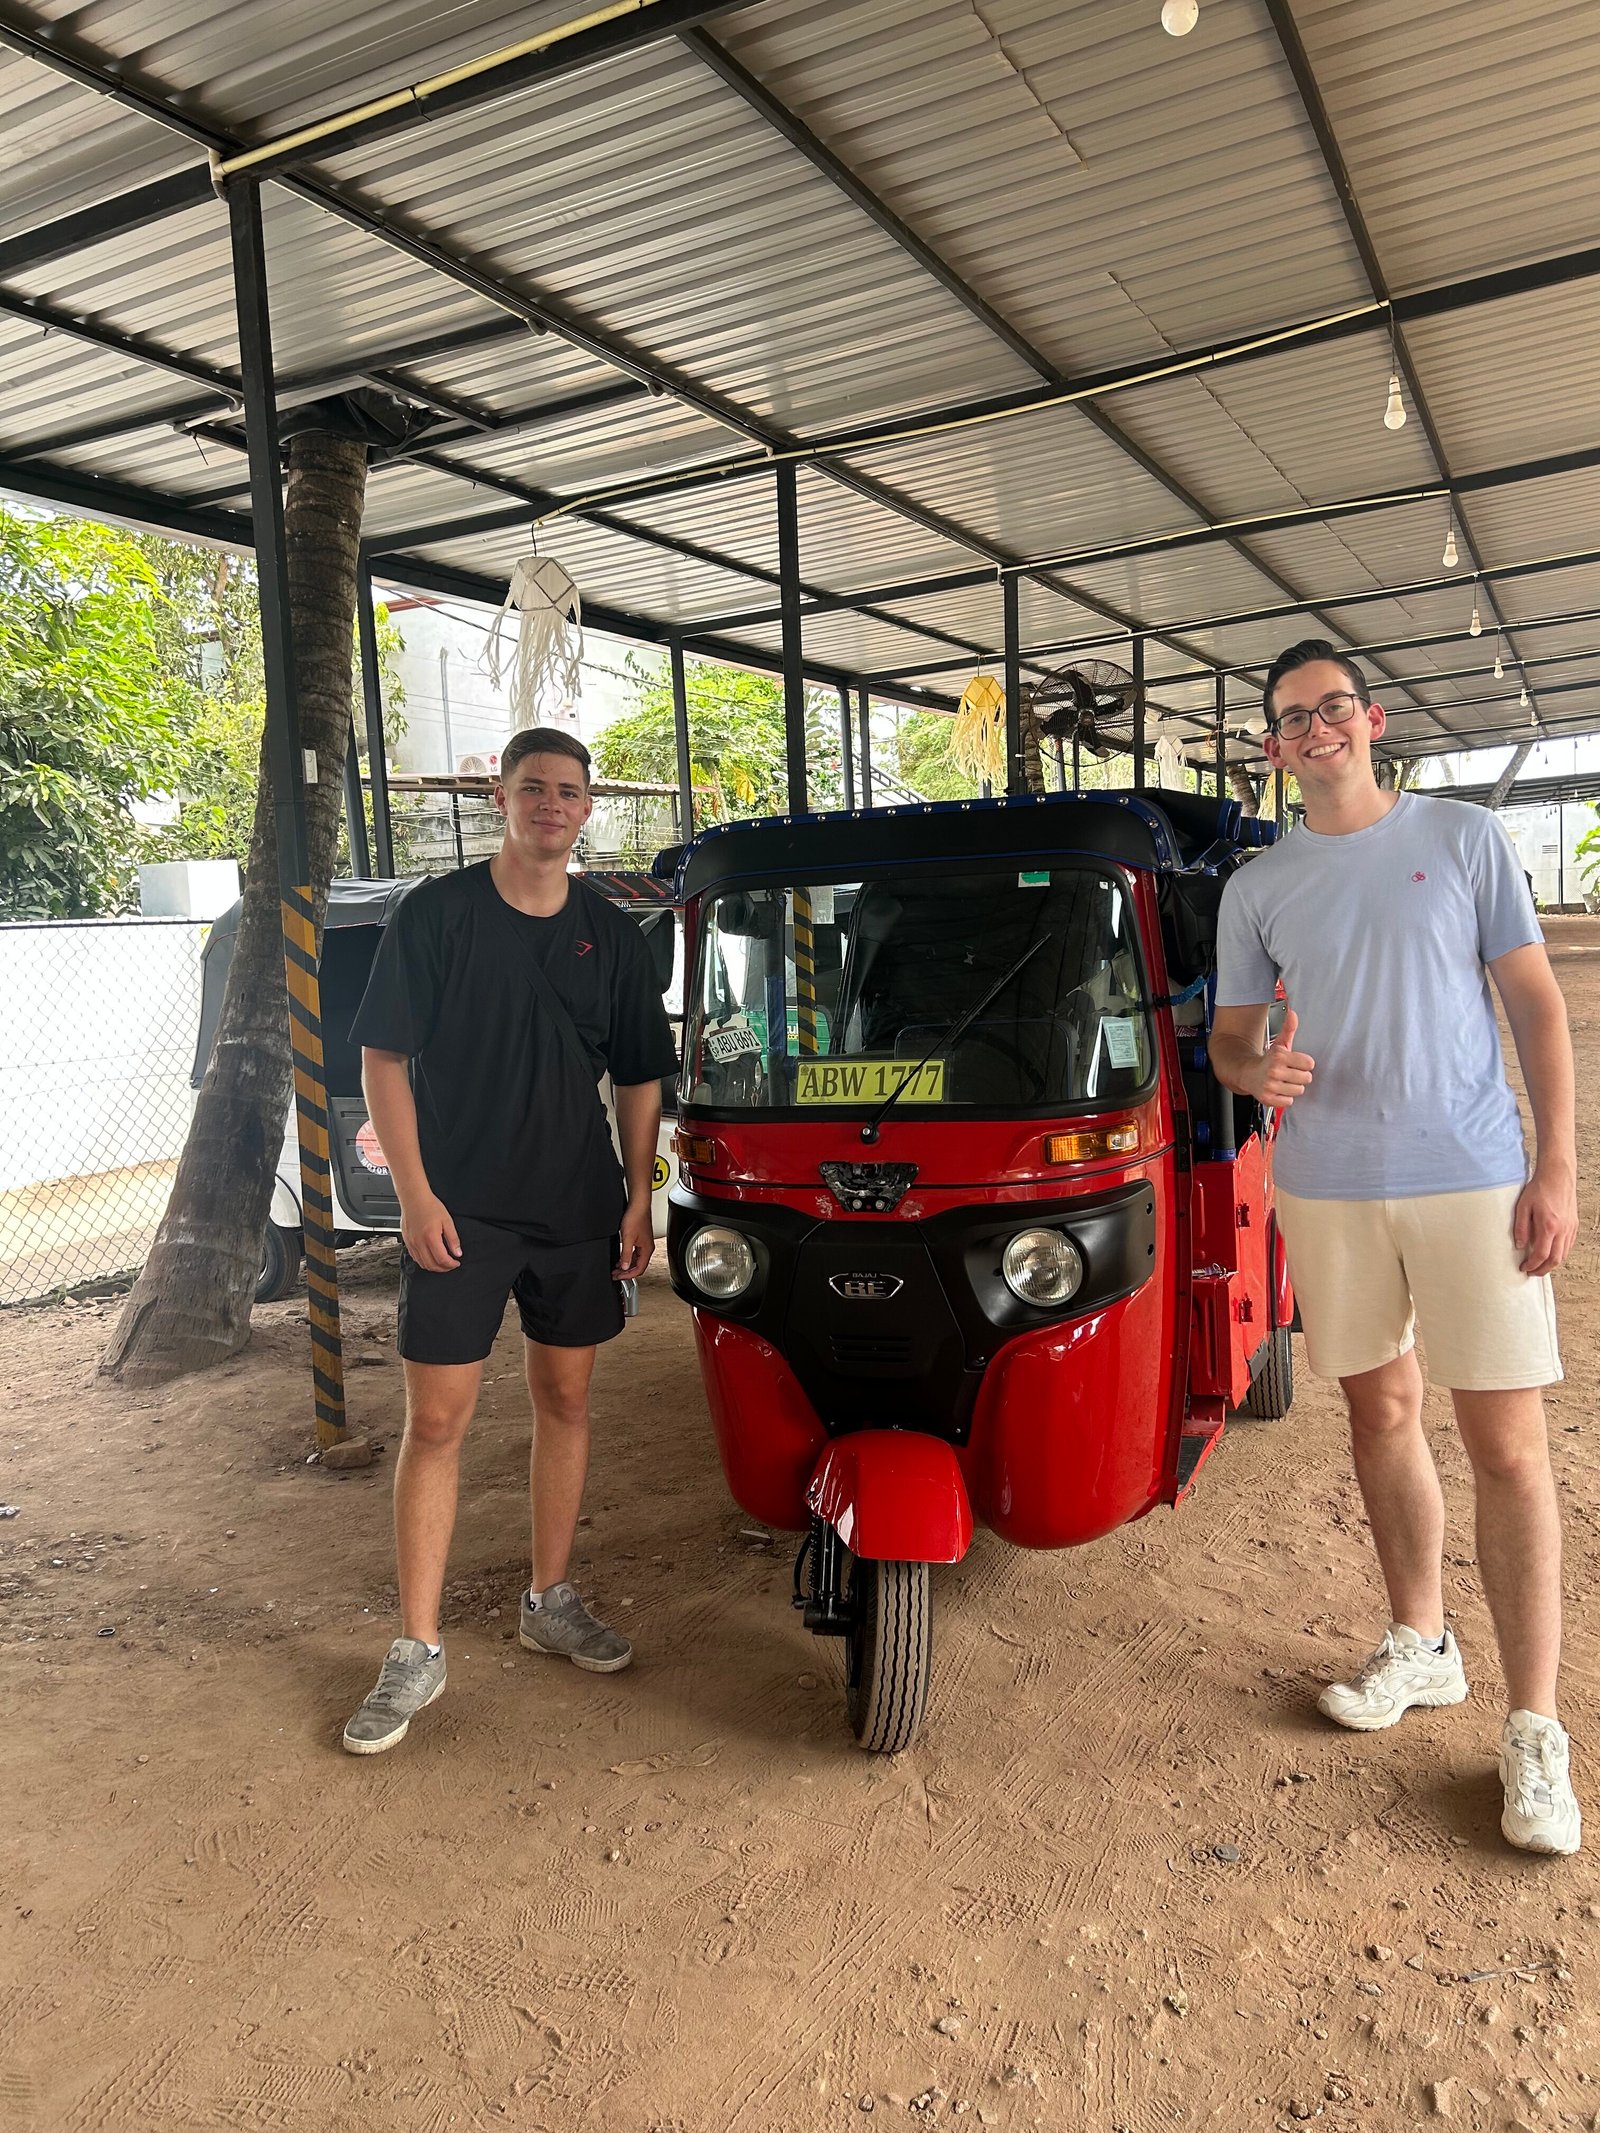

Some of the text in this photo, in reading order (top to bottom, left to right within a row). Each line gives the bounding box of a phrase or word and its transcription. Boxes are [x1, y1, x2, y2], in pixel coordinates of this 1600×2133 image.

[716, 1033, 739, 1055] ABU
[801, 1065, 942, 1098] ABW 1777
[845, 1281, 886, 1297] RE
